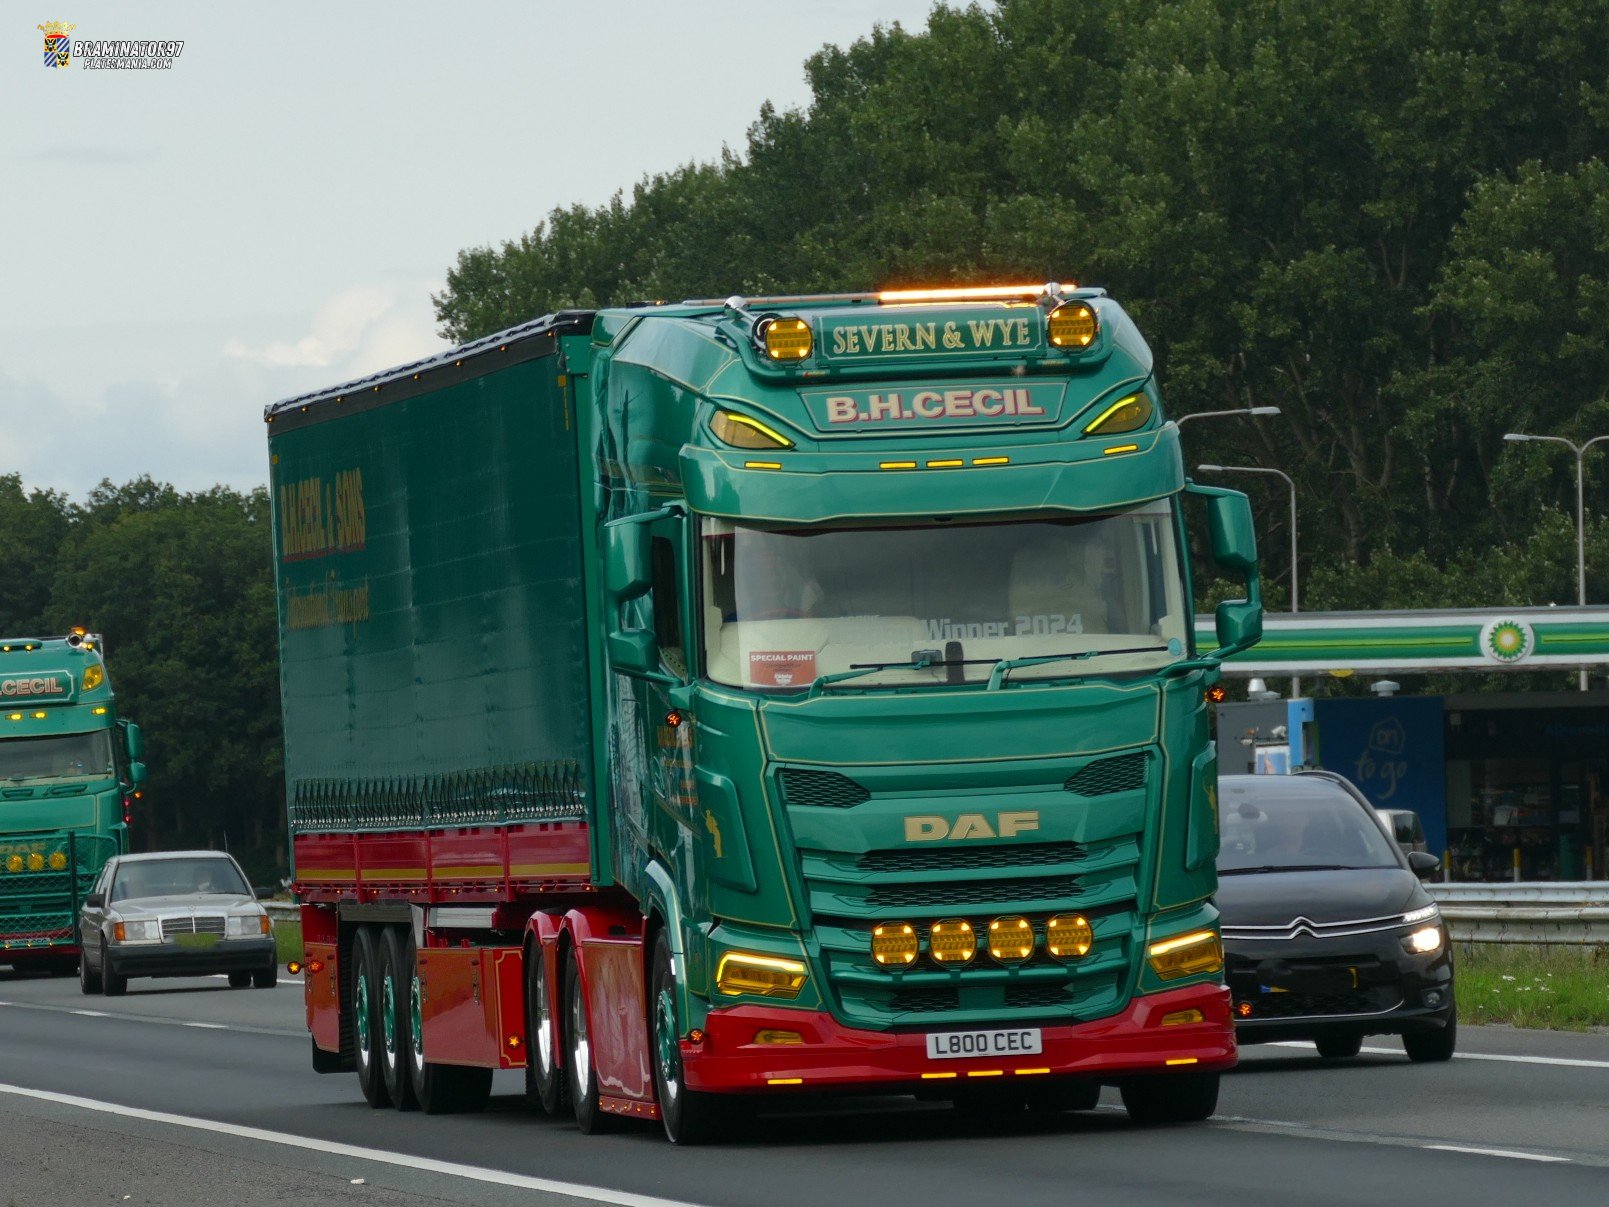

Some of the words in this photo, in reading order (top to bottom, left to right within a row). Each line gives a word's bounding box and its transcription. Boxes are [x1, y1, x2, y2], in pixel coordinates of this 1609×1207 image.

[833, 322, 936, 354] SEVERN
[943, 321, 965, 348] &
[968, 318, 1030, 346] WYE
[826, 389, 1045, 424] B.H.CECIL
[921, 618, 1008, 641] Winner
[1015, 614, 1083, 636] 2024
[751, 654, 786, 662] SPECIAL
[904, 811, 1039, 841] DAF
[935, 1034, 988, 1054] L800
[994, 1032, 1033, 1051] CEC
